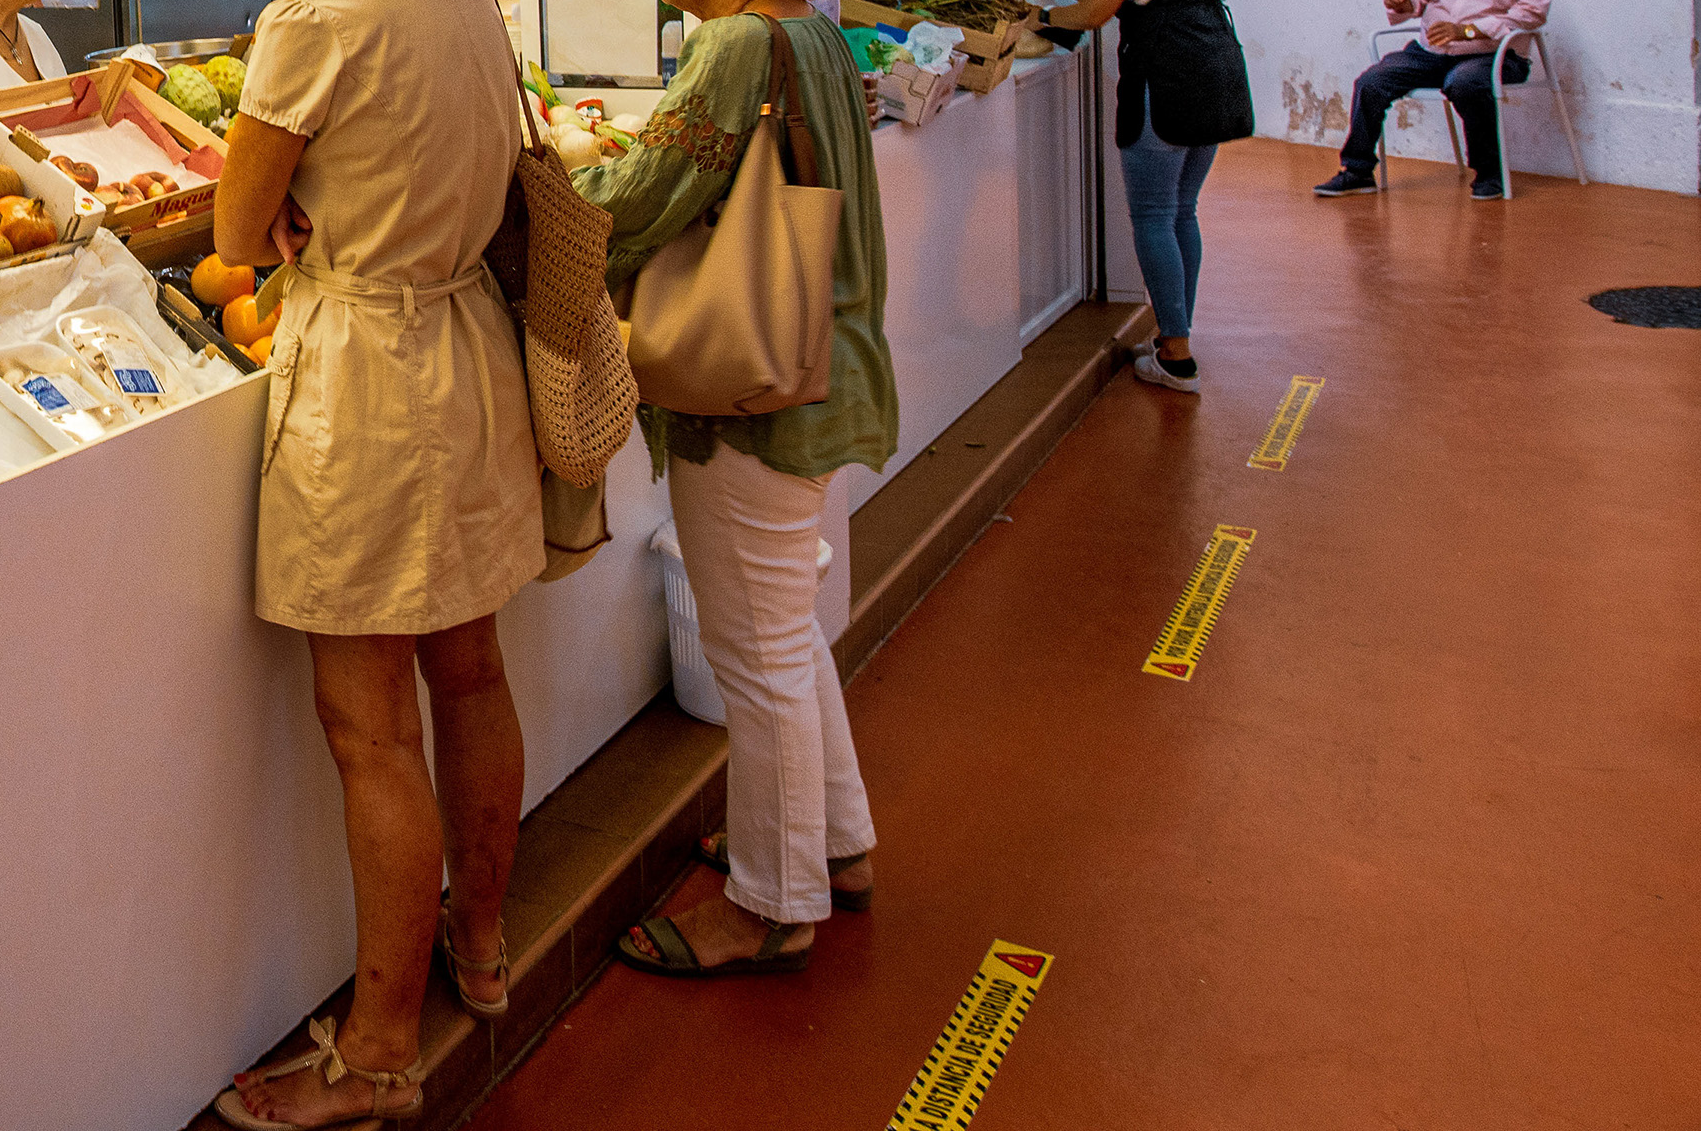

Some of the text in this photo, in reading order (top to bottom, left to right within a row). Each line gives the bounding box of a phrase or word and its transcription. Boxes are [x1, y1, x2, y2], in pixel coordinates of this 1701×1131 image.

[964, 978, 1018, 1039] SEGURIDAD
[954, 1036, 987, 1058] DE
[919, 1054, 980, 1120] DISTANCIA
